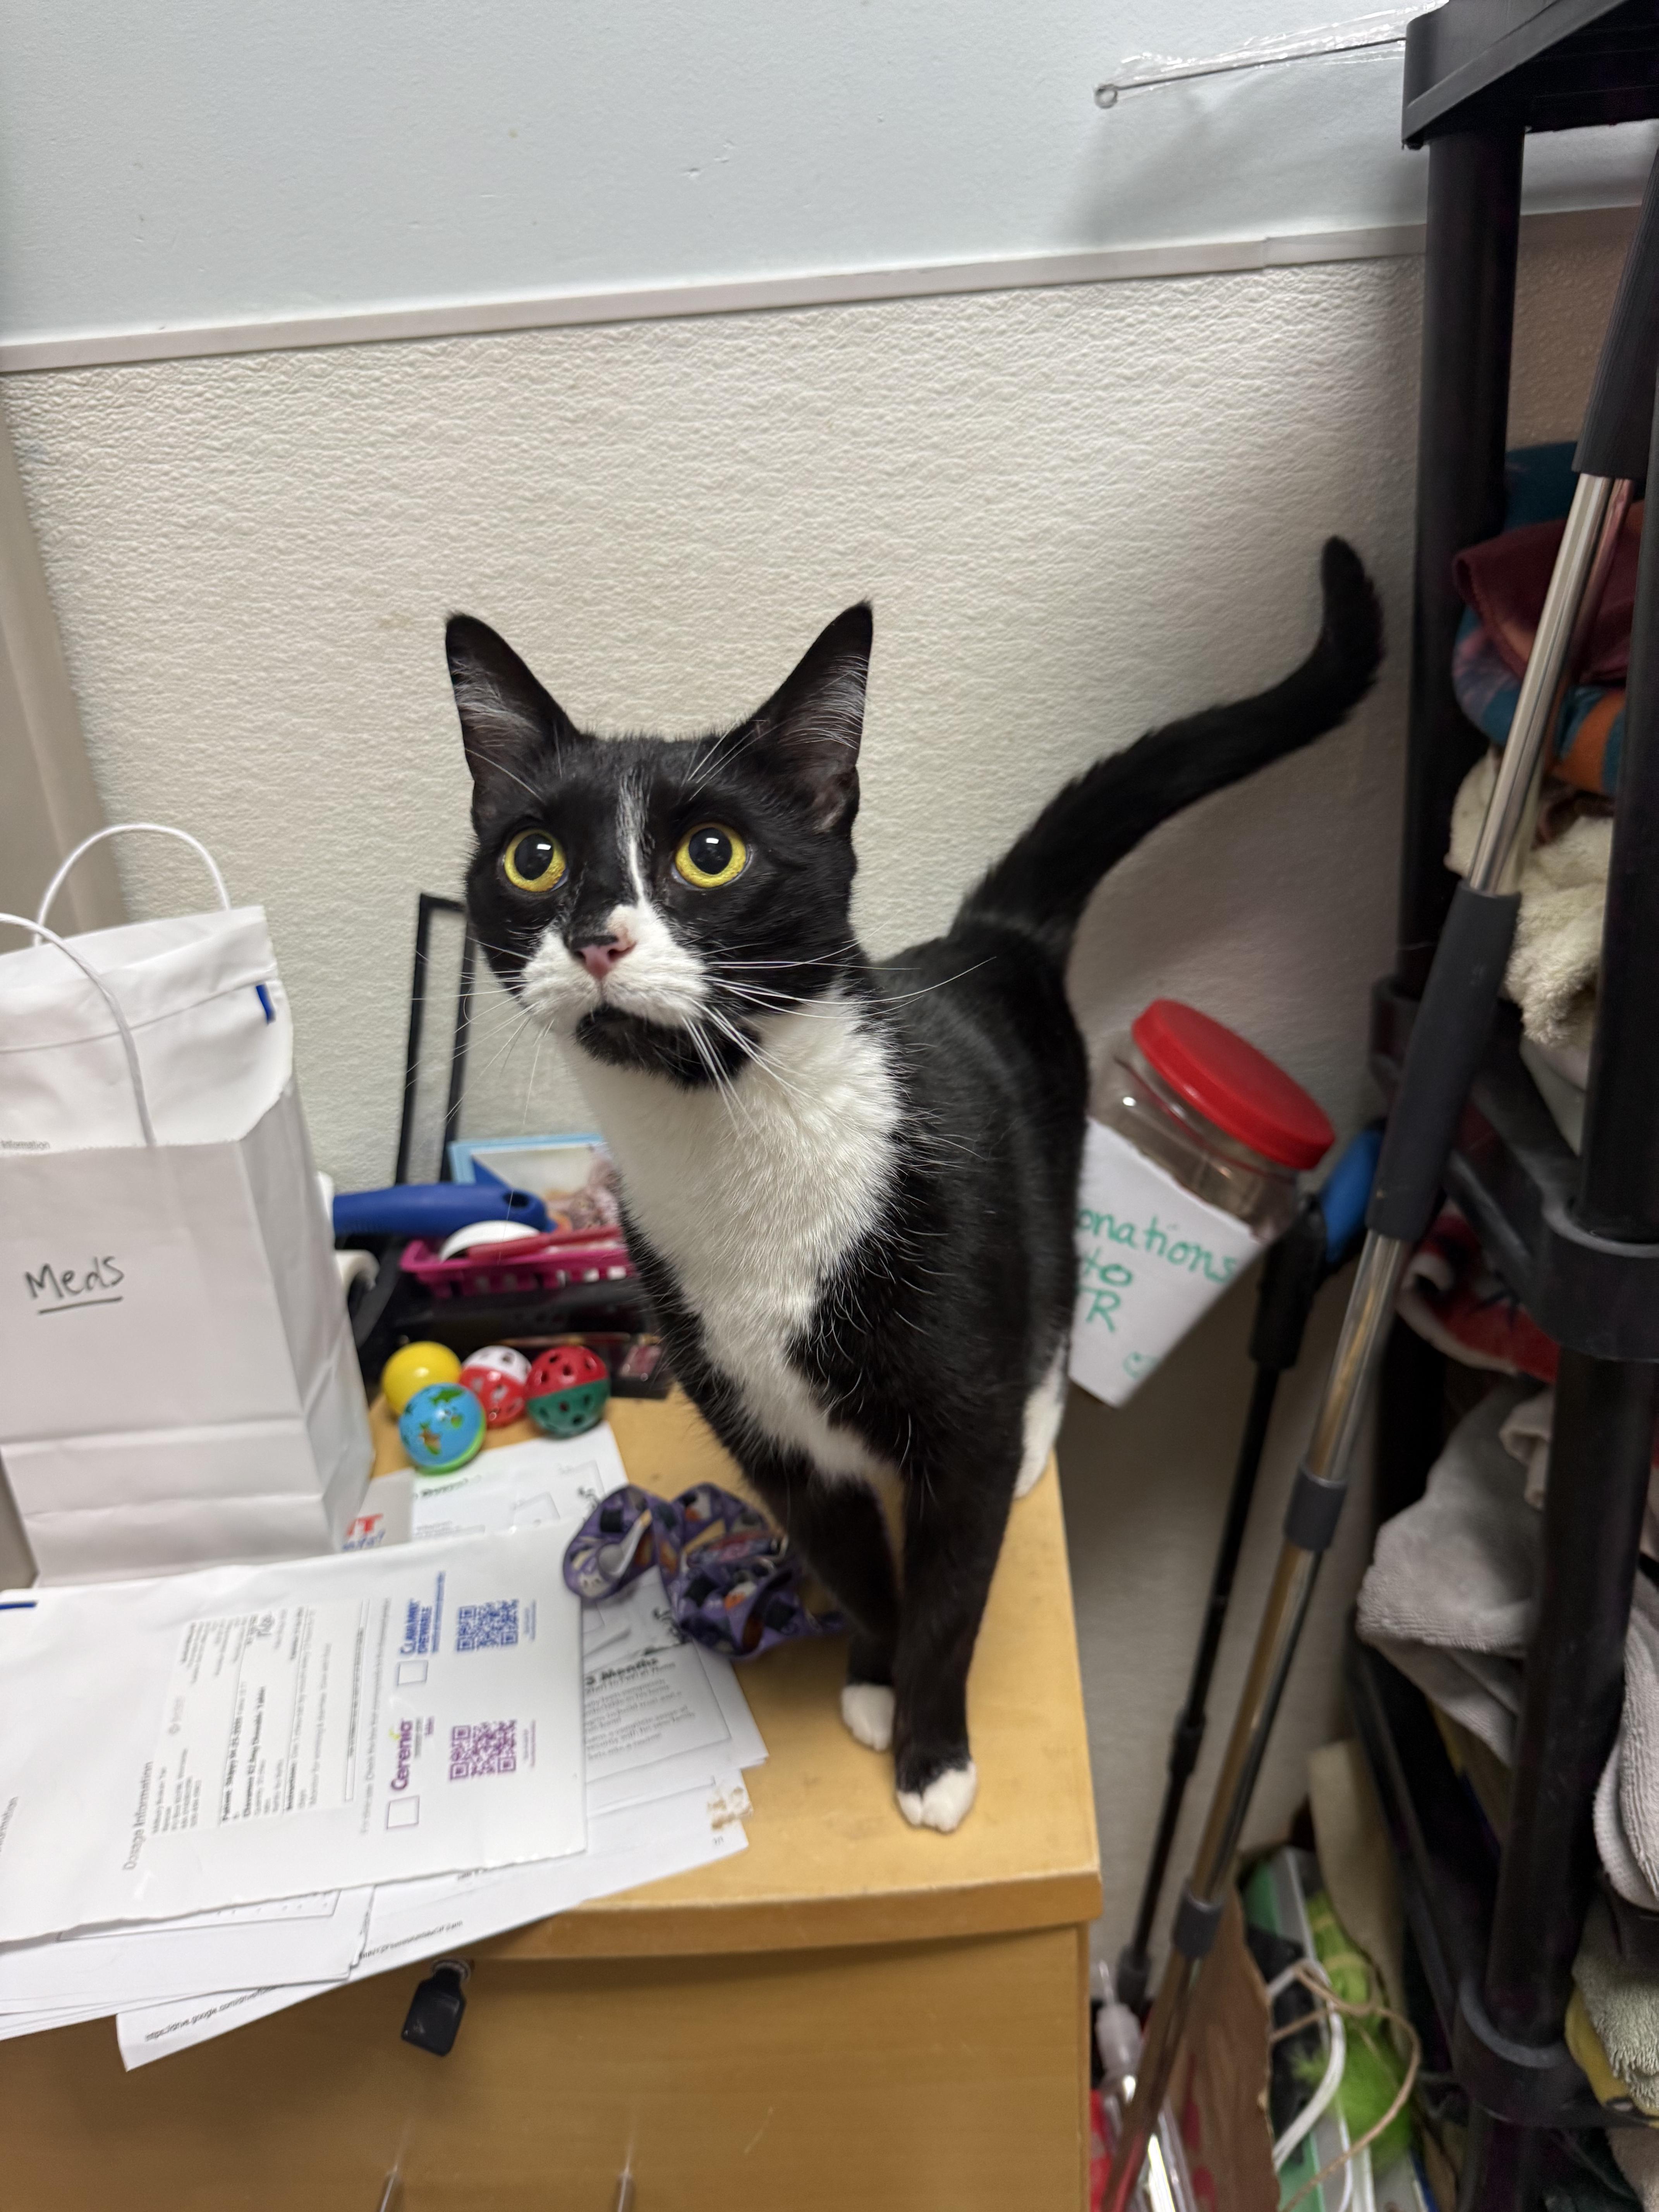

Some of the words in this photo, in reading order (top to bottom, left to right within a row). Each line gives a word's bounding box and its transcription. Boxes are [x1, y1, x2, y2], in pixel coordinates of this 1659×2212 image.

[1075, 1207, 1237, 1283] onations
[1084, 1248, 1133, 1287] to
[1079, 1285, 1121, 1333] R
[391, 1719, 412, 1791] Cerenia
